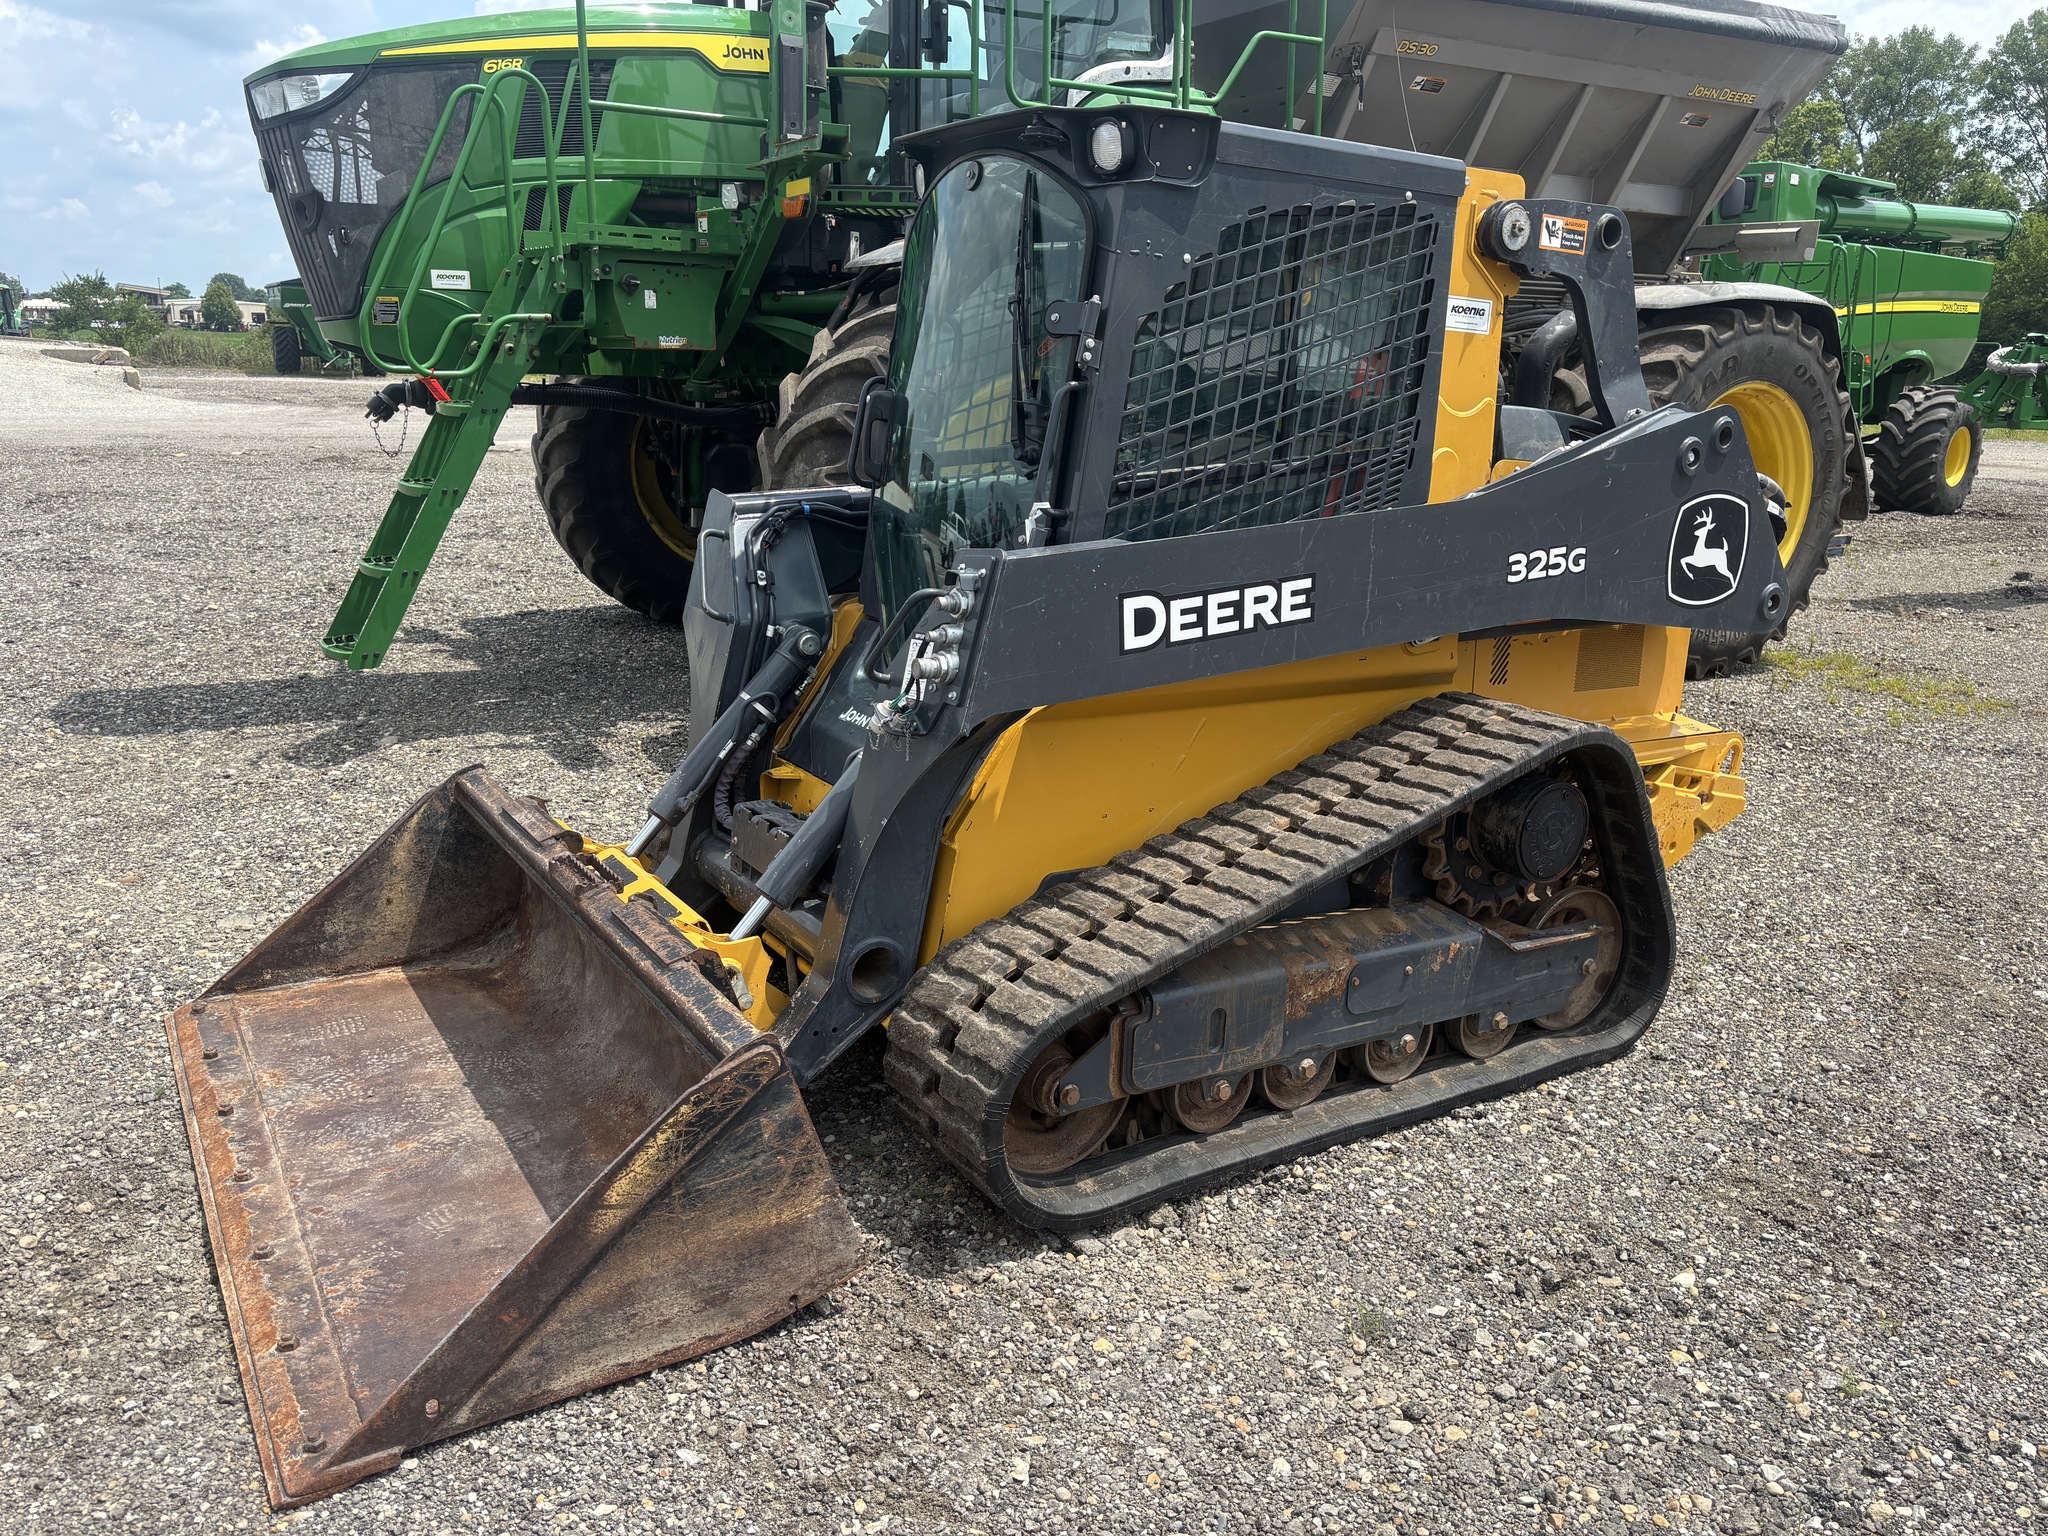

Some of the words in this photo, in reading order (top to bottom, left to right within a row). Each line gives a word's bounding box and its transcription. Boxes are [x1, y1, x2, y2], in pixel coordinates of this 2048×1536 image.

[722, 44, 765, 60] JOHN
[483, 58, 523, 73] 616R
[1687, 84, 1721, 100] JOHN
[1719, 88, 1757, 105] DEERE
[659, 336, 687, 345] Nutrien
[1507, 546, 1587, 583] 325G
[1122, 577, 1313, 651] DEERE
[839, 706, 871, 728] JOHN
